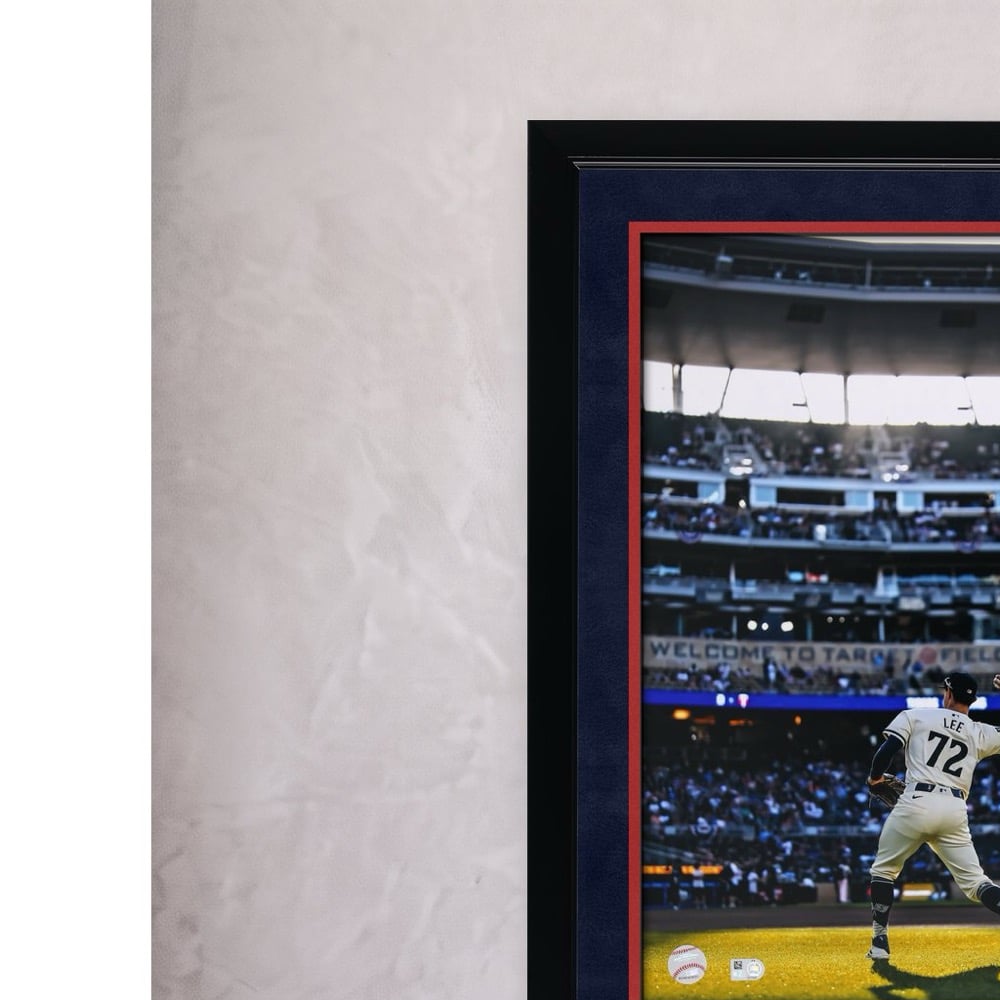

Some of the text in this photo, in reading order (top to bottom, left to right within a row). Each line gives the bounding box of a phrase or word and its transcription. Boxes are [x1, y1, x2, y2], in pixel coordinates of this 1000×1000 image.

[650, 641, 774, 660] WELCOME
[784, 646, 815, 661] TO
[943, 717, 965, 733] LEE
[926, 730, 969, 778] 72
